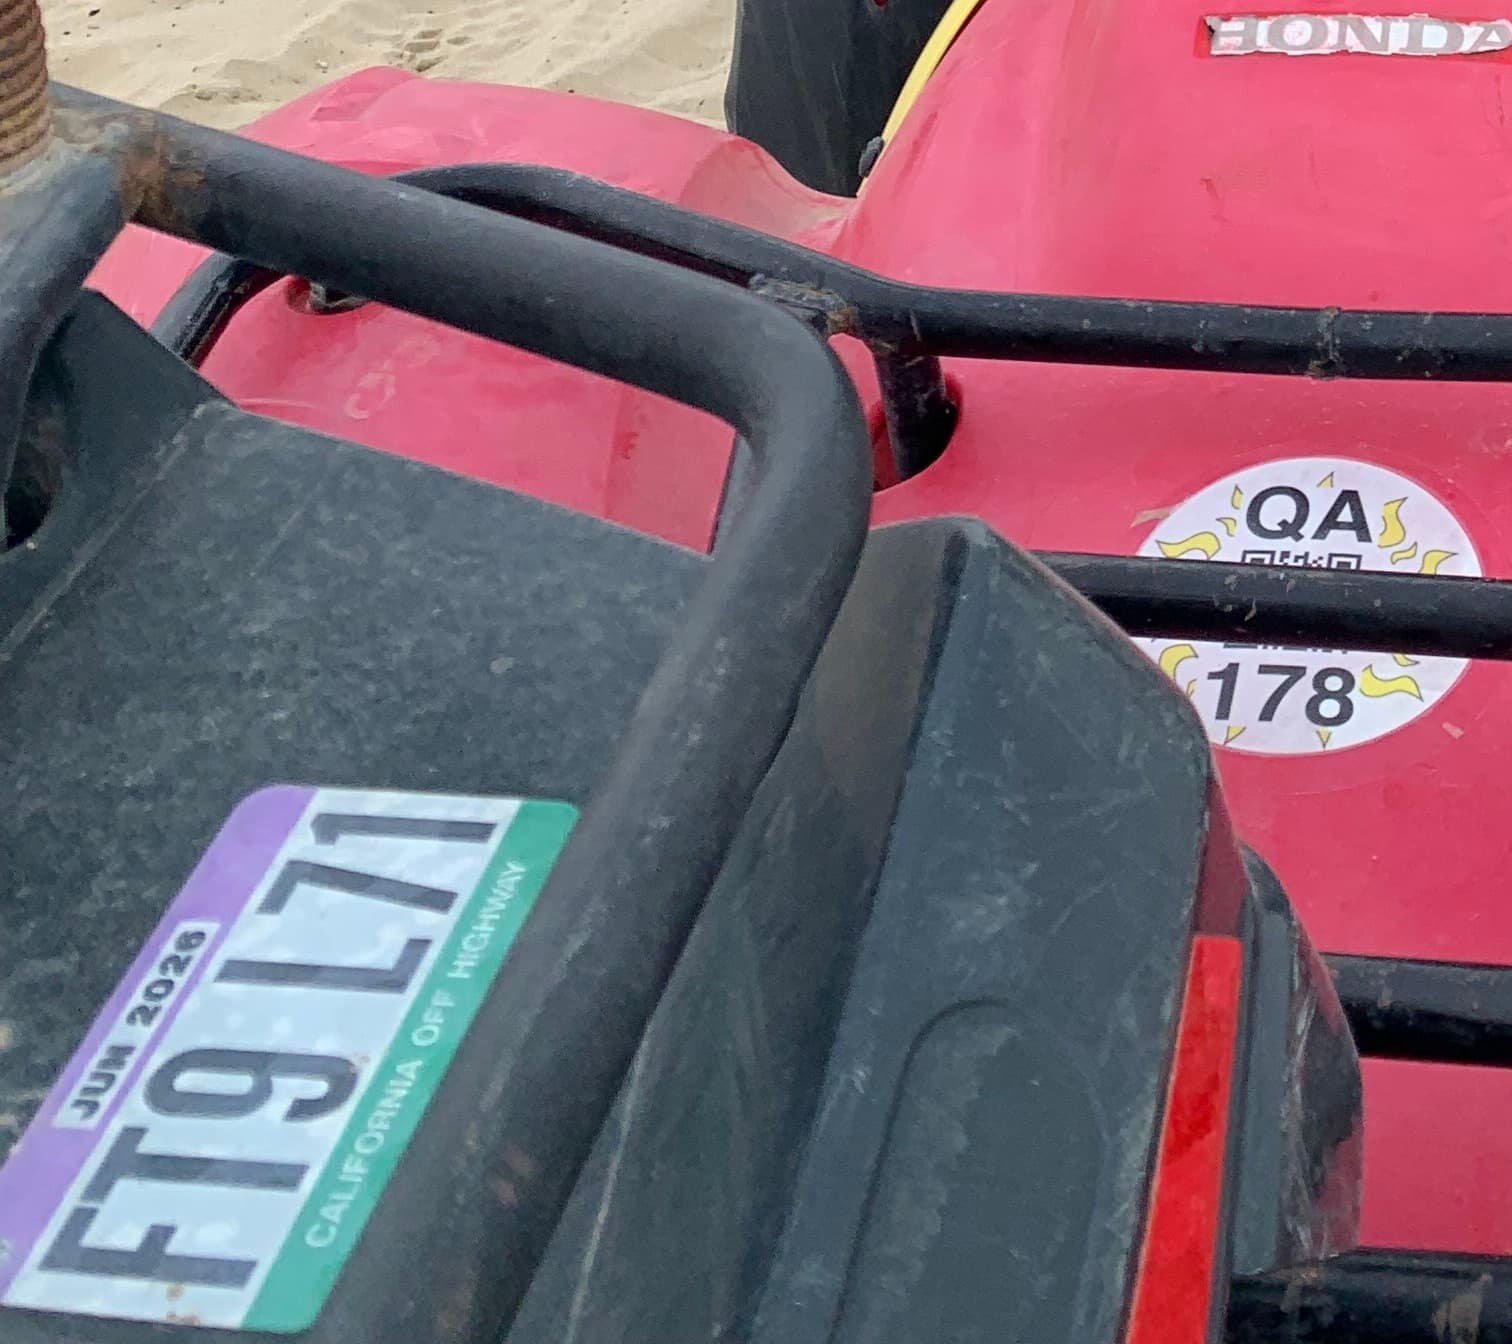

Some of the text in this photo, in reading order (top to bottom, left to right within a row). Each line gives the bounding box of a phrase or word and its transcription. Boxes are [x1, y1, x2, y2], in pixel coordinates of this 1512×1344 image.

[1245, 485, 1373, 544] QA
[1207, 662, 1356, 727] 178
[70, 931, 206, 1121] JUN 2026
[305, 860, 526, 1249] CALIFORNIA OFF HIGHWAY
